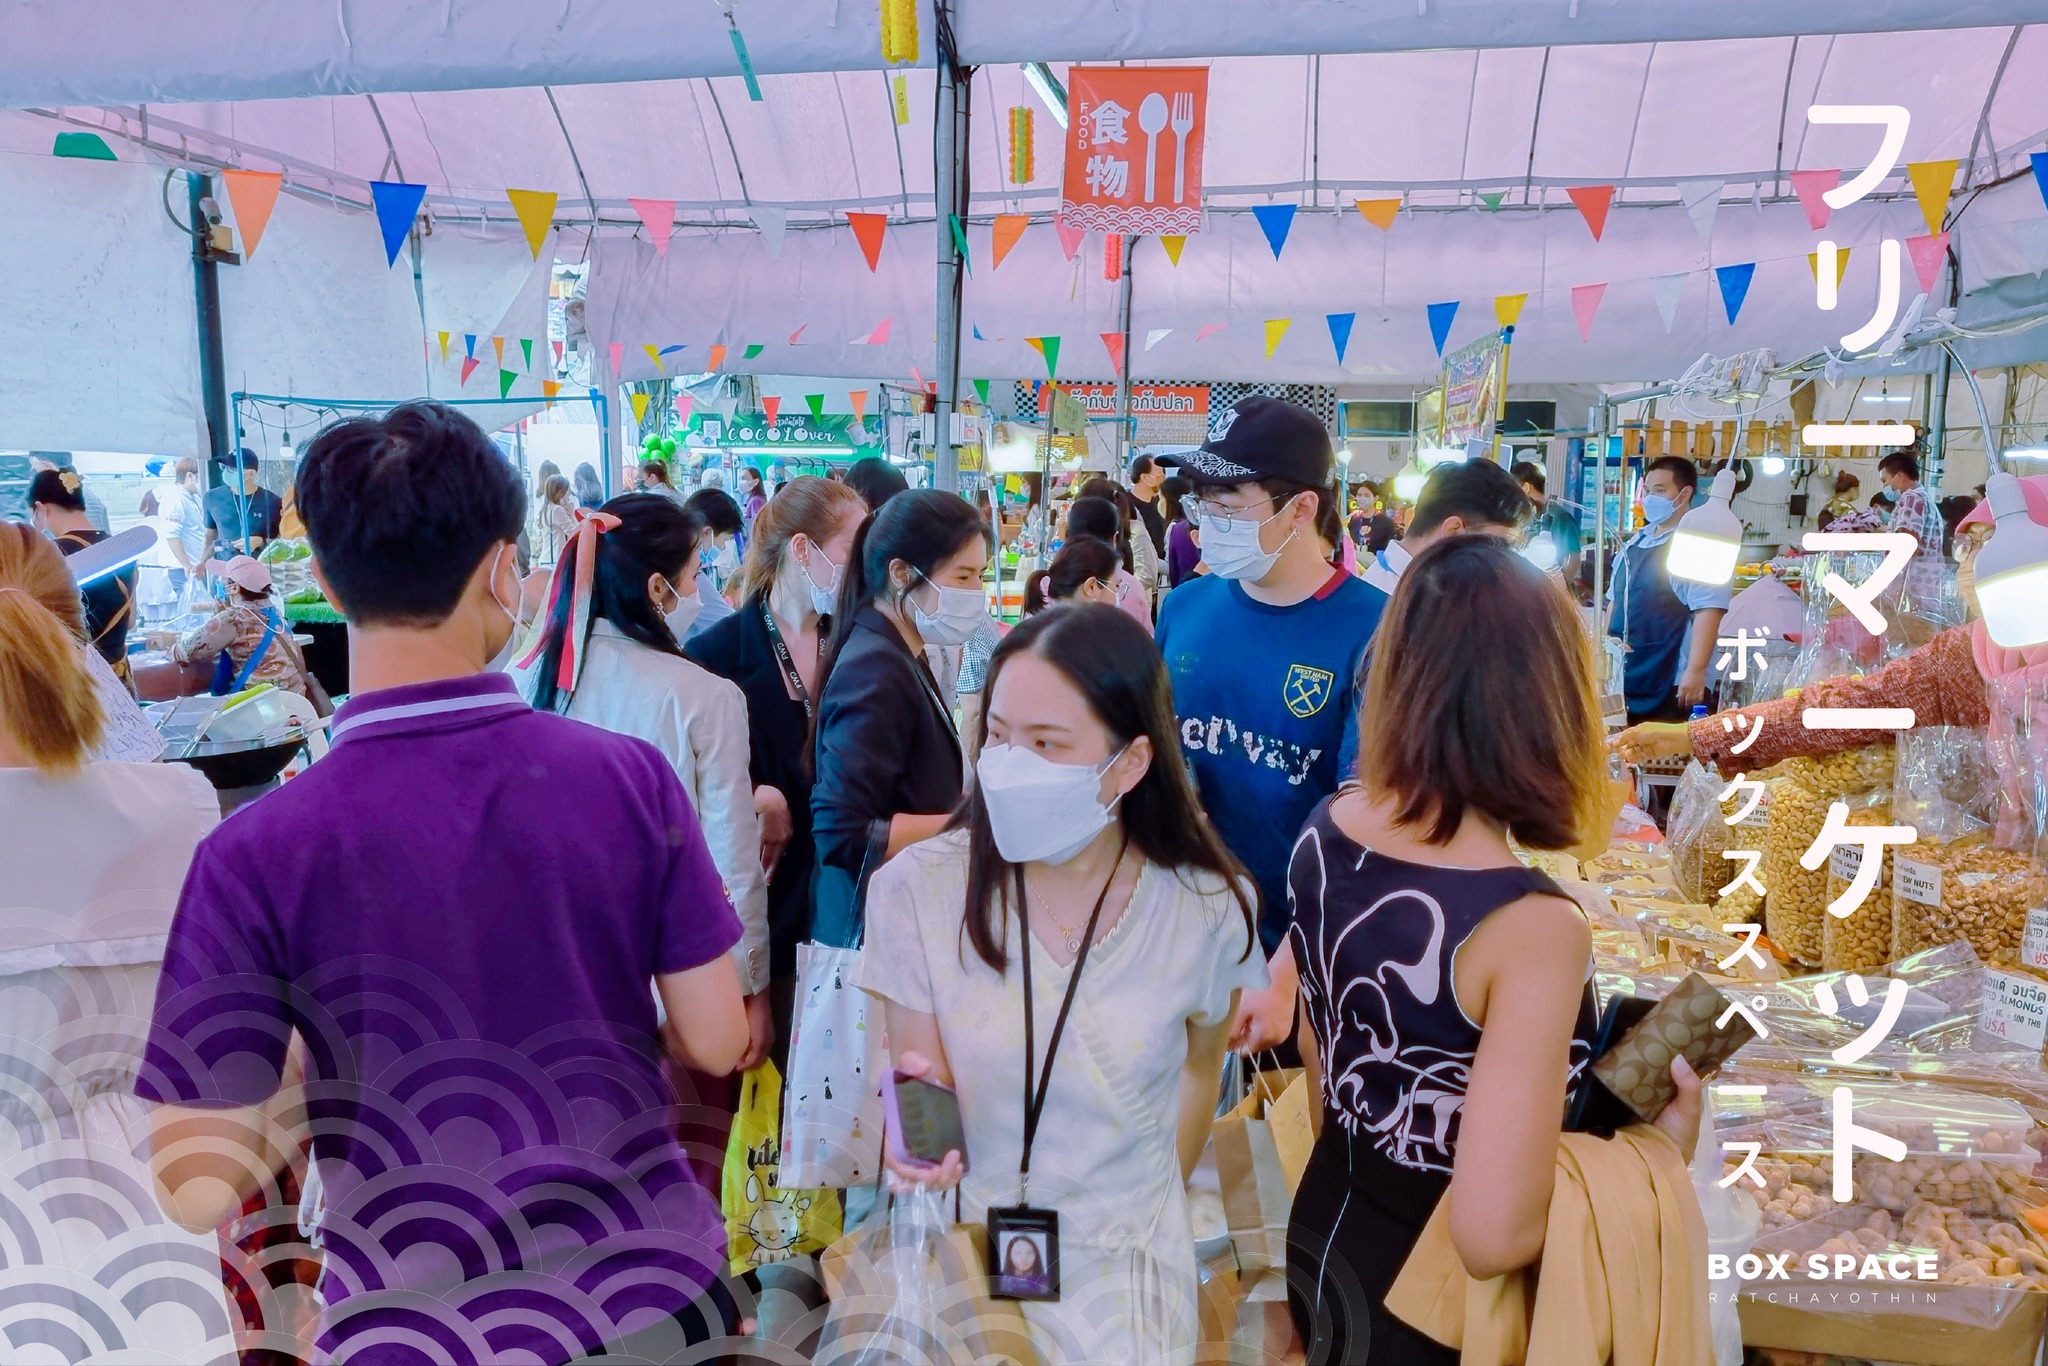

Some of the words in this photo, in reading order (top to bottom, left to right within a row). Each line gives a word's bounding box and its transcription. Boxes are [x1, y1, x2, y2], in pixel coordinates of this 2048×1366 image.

[1078, 102, 1090, 150] FOOD
[1085, 100, 1131, 198] 食物
[1294, 667, 1313, 677] WEST
[1313, 671, 1328, 681] HAM
[1913, 879, 1935, 891] NUTS
[1999, 994, 2045, 1016] ALMONDS
[1984, 1016, 2006, 1037] USA
[2027, 1017, 2042, 1029] THB
